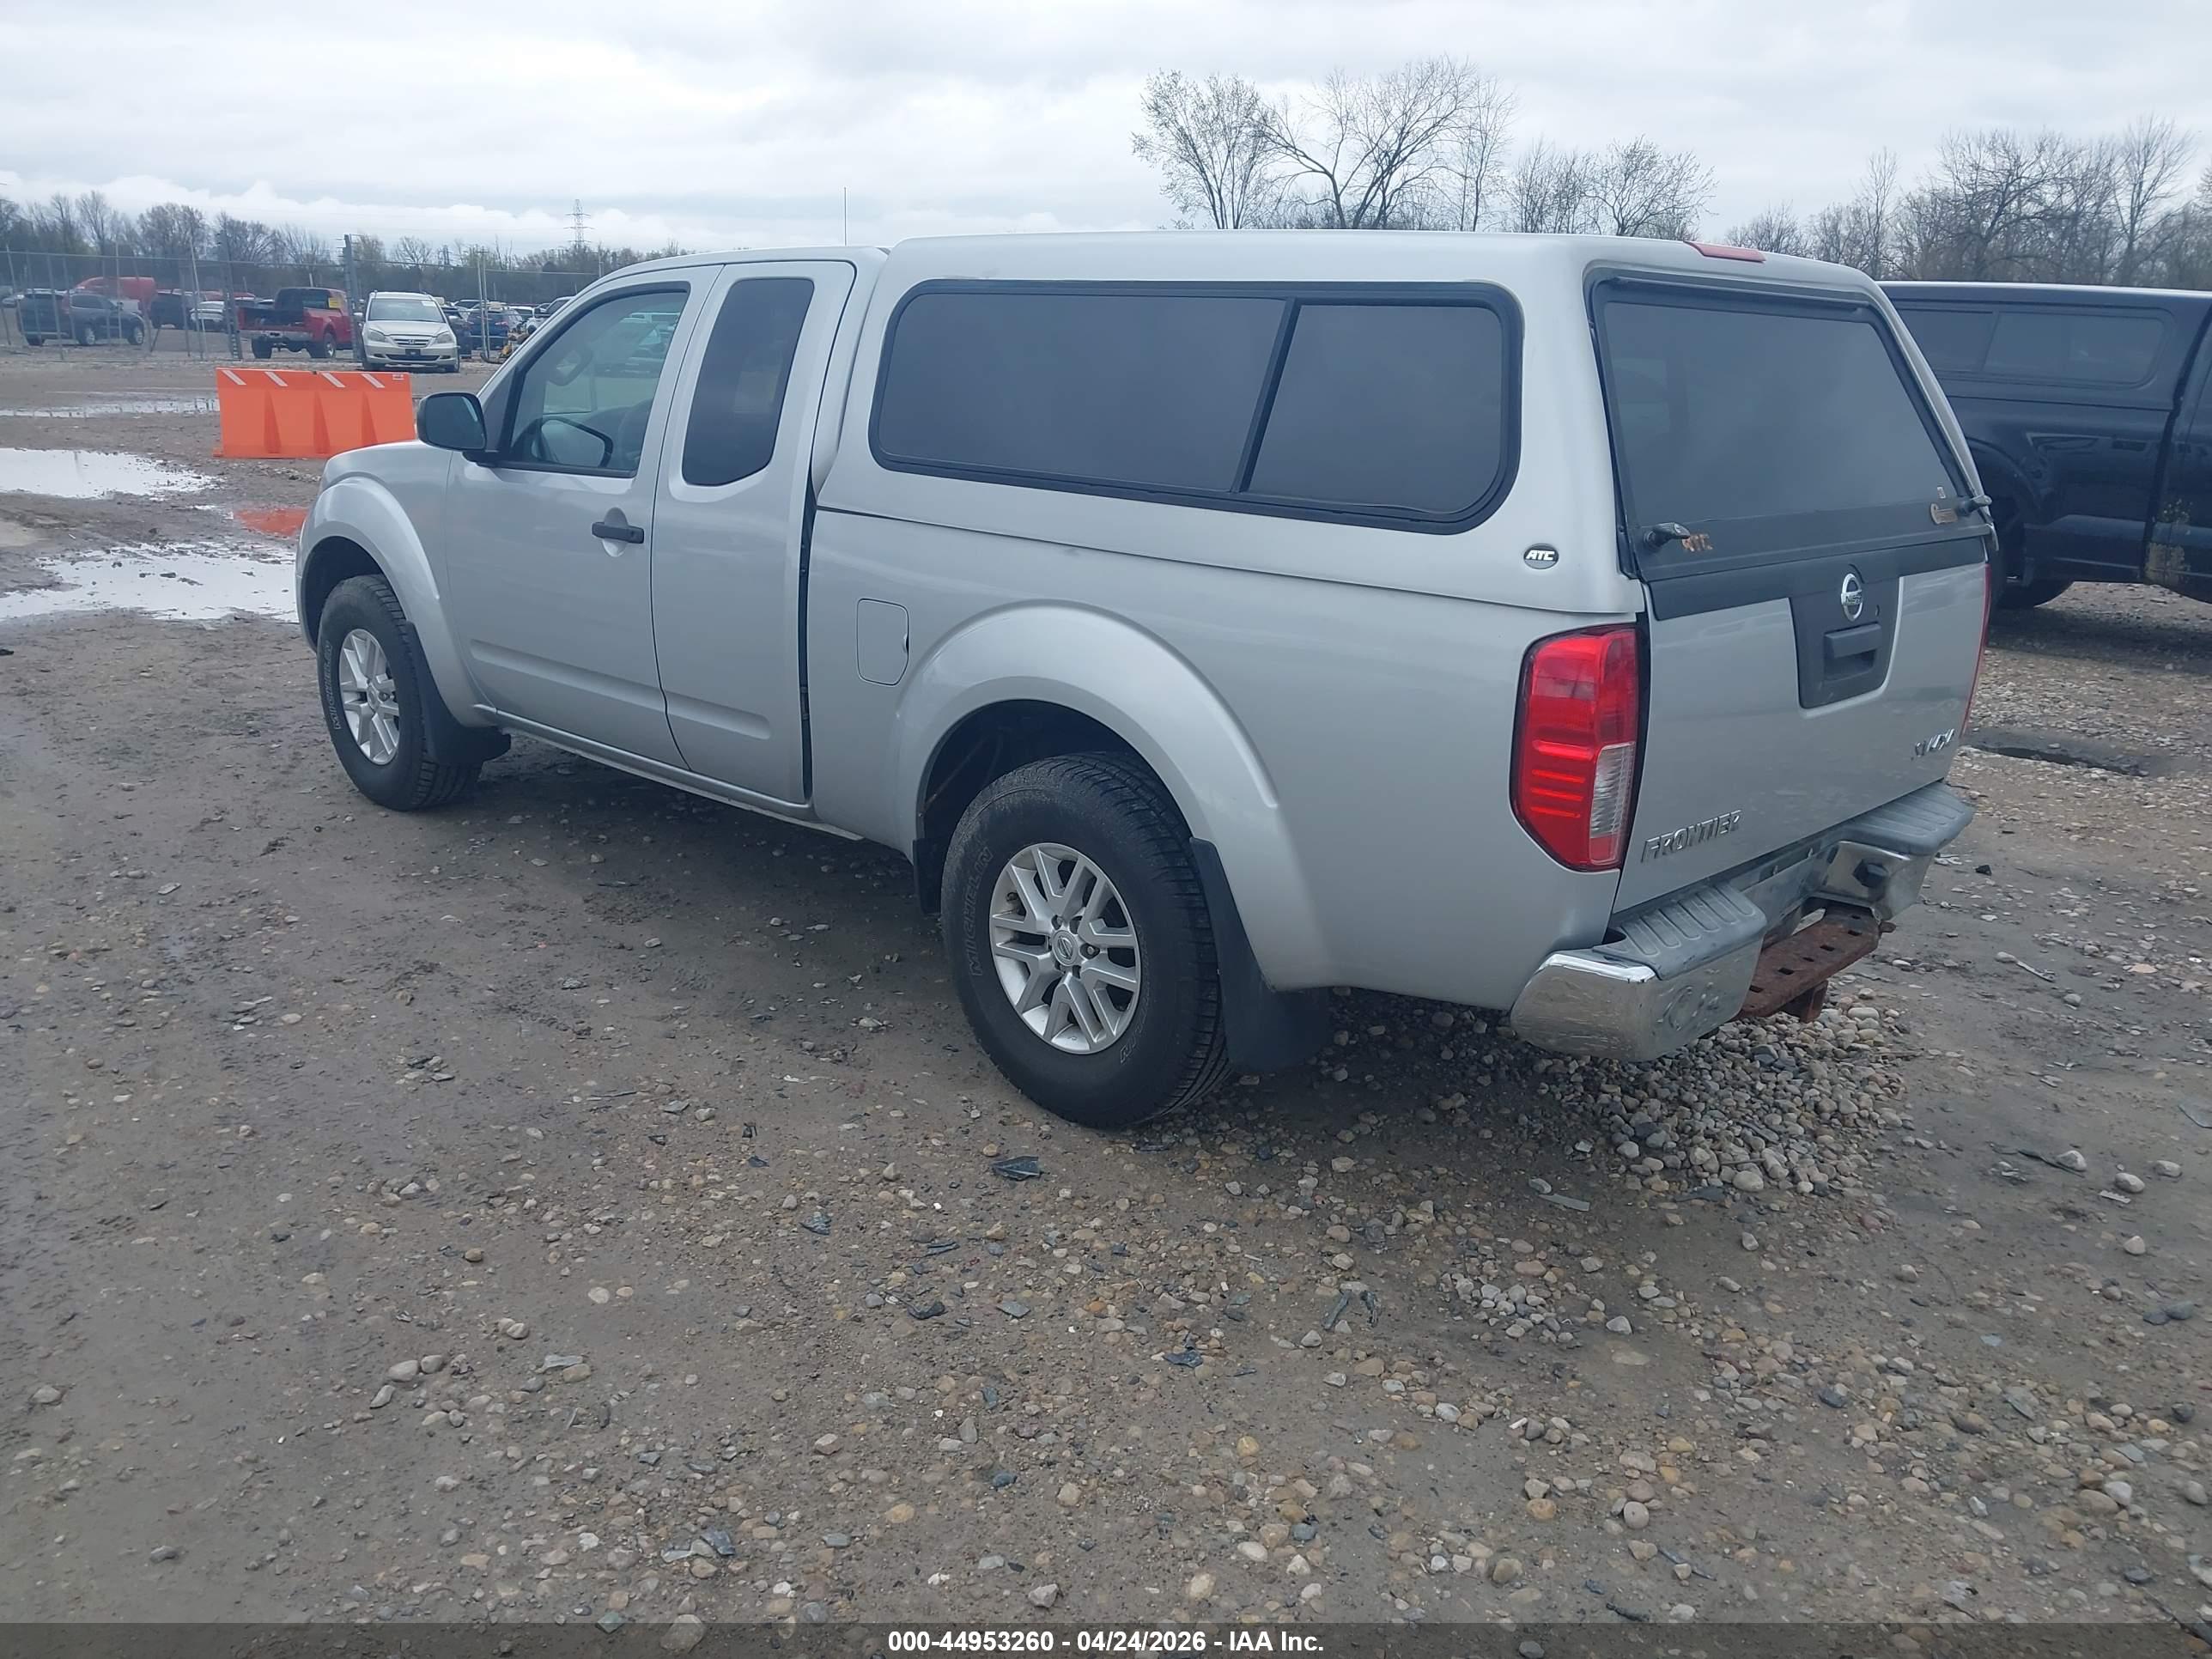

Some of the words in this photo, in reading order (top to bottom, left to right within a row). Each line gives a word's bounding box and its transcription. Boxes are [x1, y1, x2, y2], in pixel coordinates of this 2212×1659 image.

[1525, 549, 1555, 561] ATC
[1640, 809, 1742, 863] FRONTIER
[963, 846, 994, 977] MICHELIN
